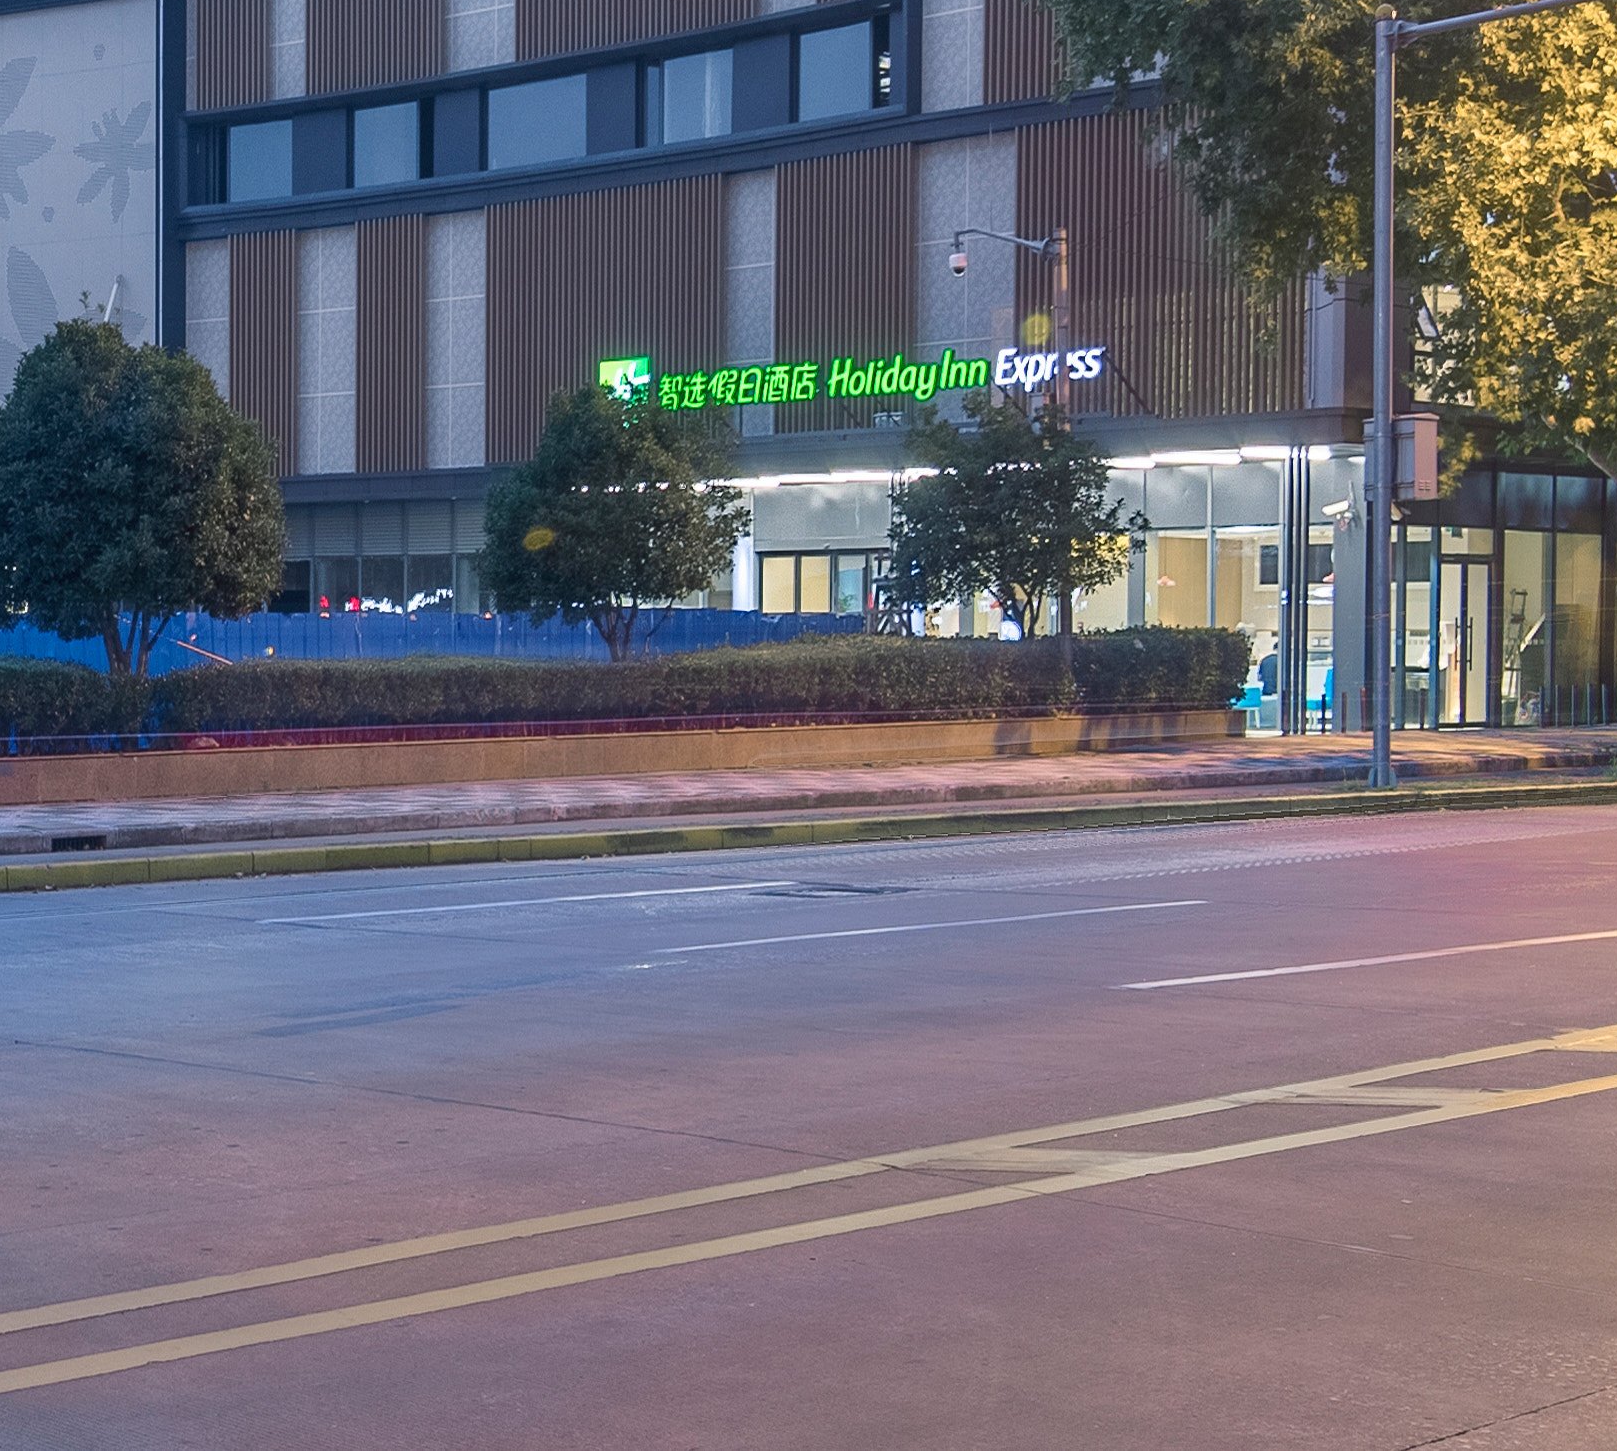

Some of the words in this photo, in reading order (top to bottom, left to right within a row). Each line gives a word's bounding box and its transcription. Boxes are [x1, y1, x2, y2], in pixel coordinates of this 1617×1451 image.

[658, 362, 819, 410] 智选假日酒店
[828, 355, 943, 400] Holiday
[940, 349, 988, 388] Inn
